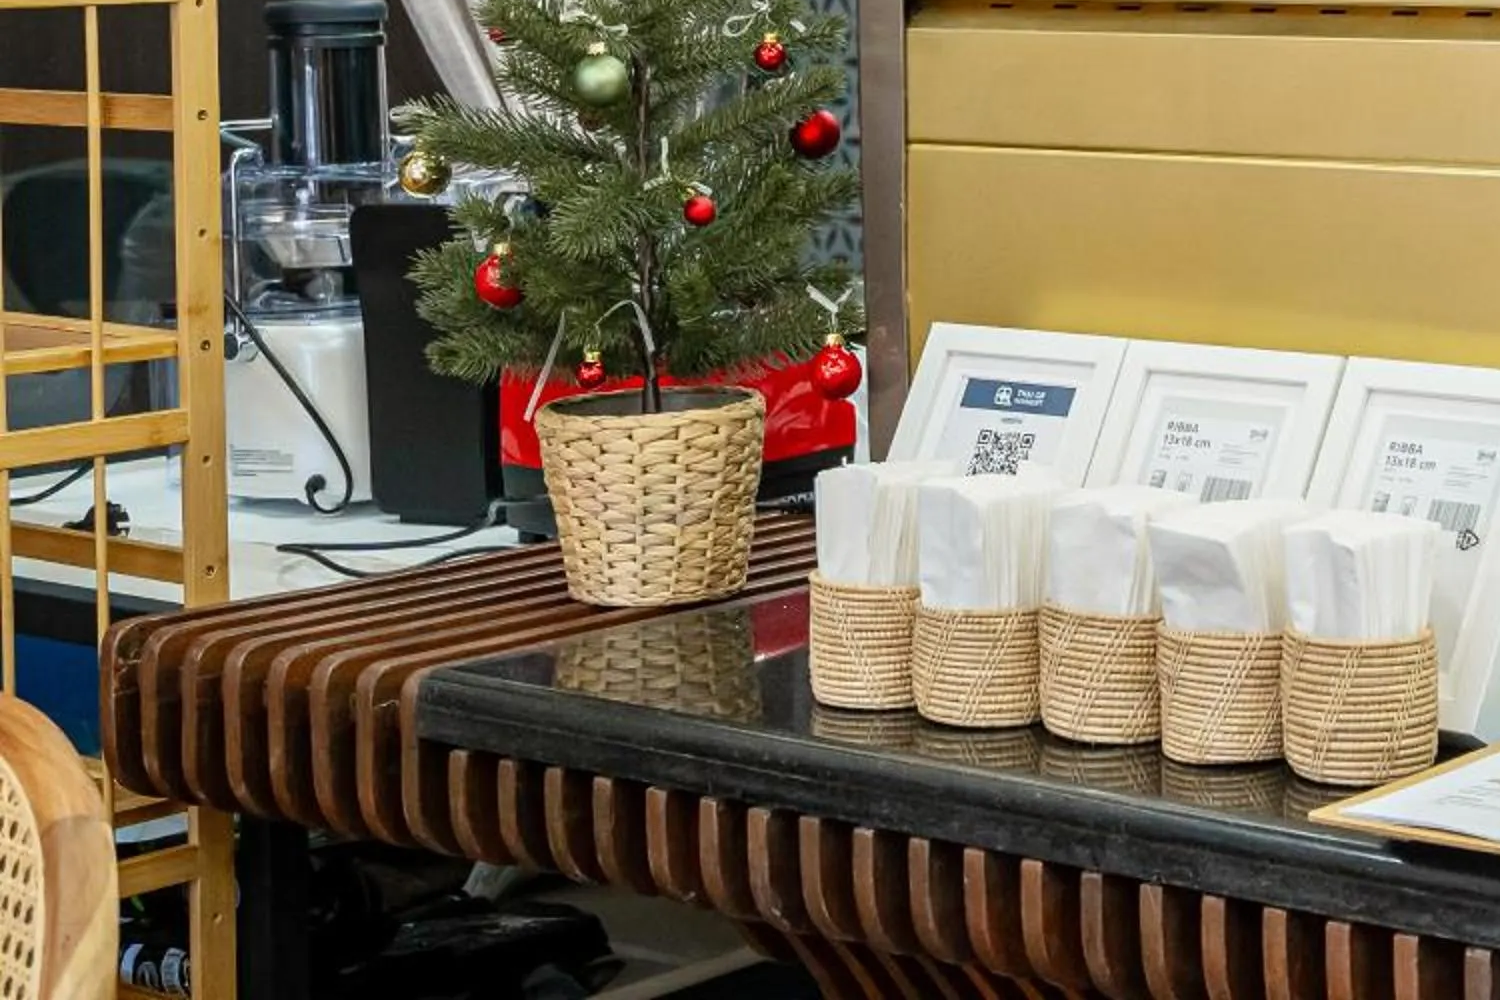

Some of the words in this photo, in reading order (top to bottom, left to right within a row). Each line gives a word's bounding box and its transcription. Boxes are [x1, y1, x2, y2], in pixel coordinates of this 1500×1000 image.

[1167, 420, 1200, 433] RIBBA
[1194, 438, 1212, 449] cm
[1389, 441, 1423, 455] RIBBA
[1419, 461, 1438, 471] cm
